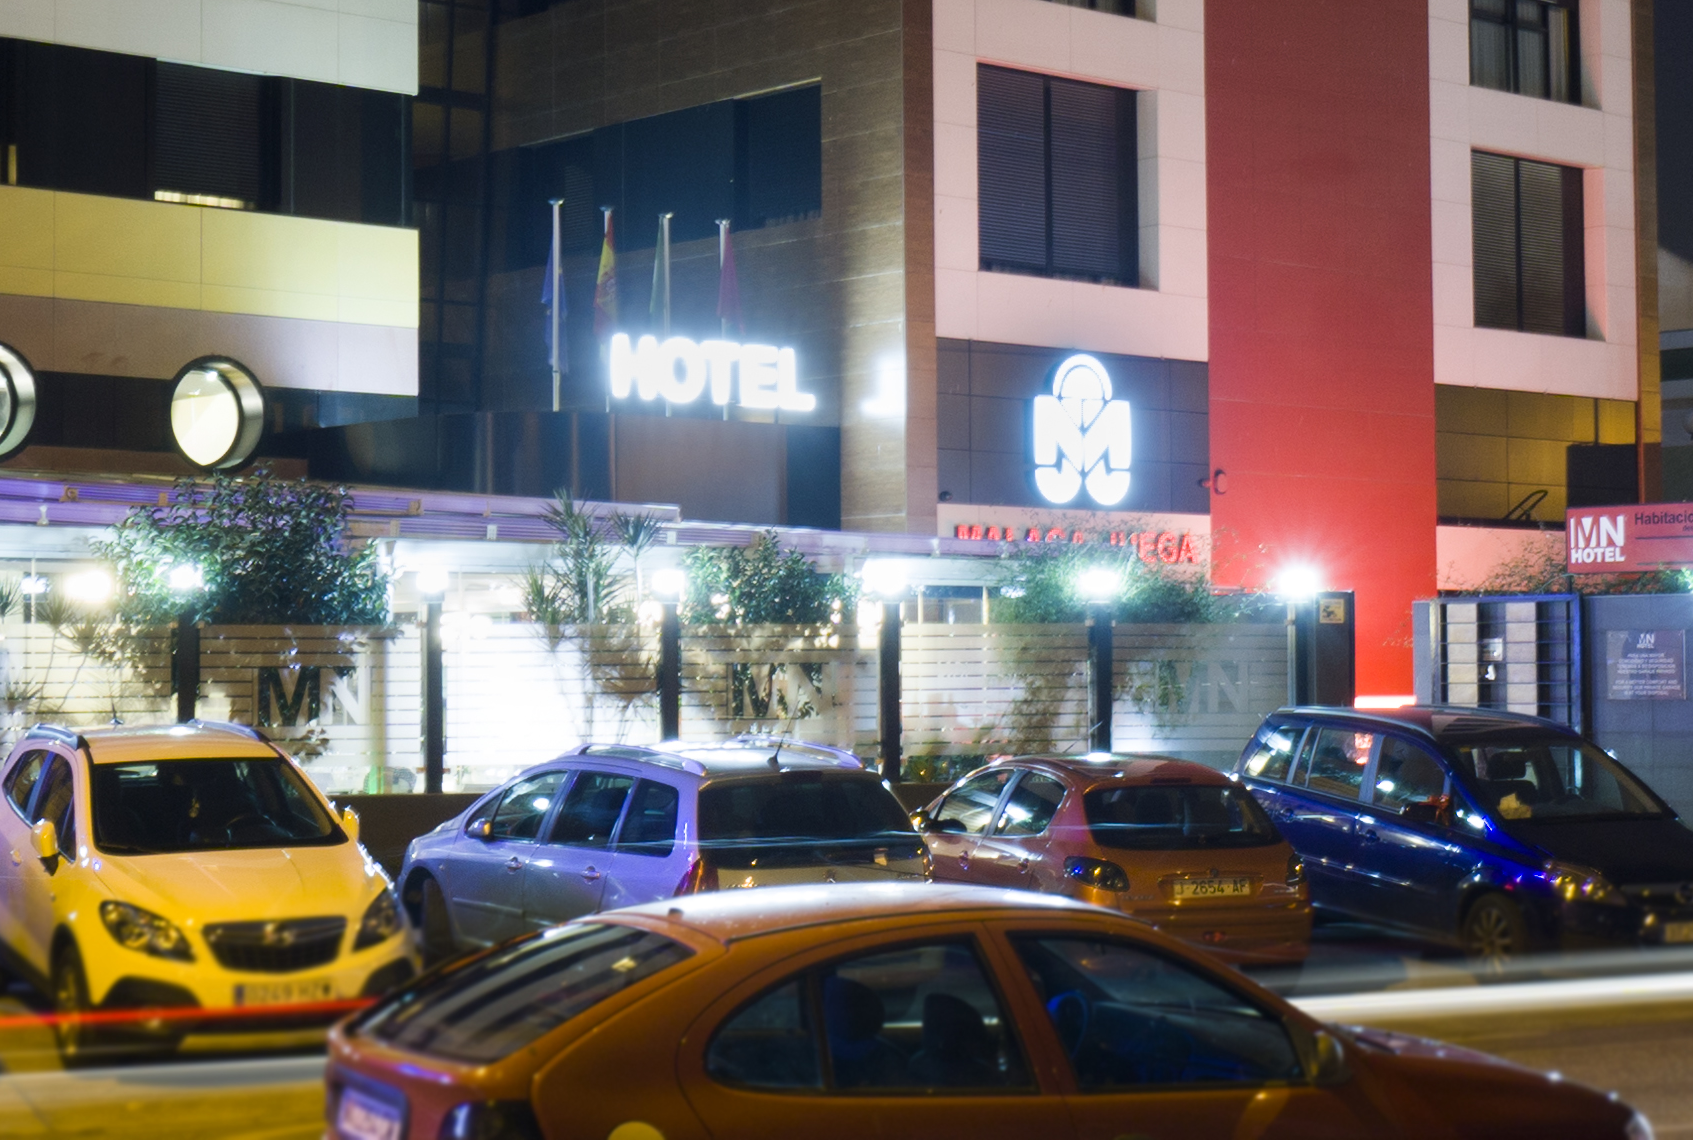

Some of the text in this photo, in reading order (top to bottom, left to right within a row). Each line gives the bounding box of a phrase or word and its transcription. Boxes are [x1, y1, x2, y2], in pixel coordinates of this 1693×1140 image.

[610, 332, 816, 411] HOTEL
[1570, 515, 1626, 548] MN
[1570, 547, 1626, 564] HOTEL
